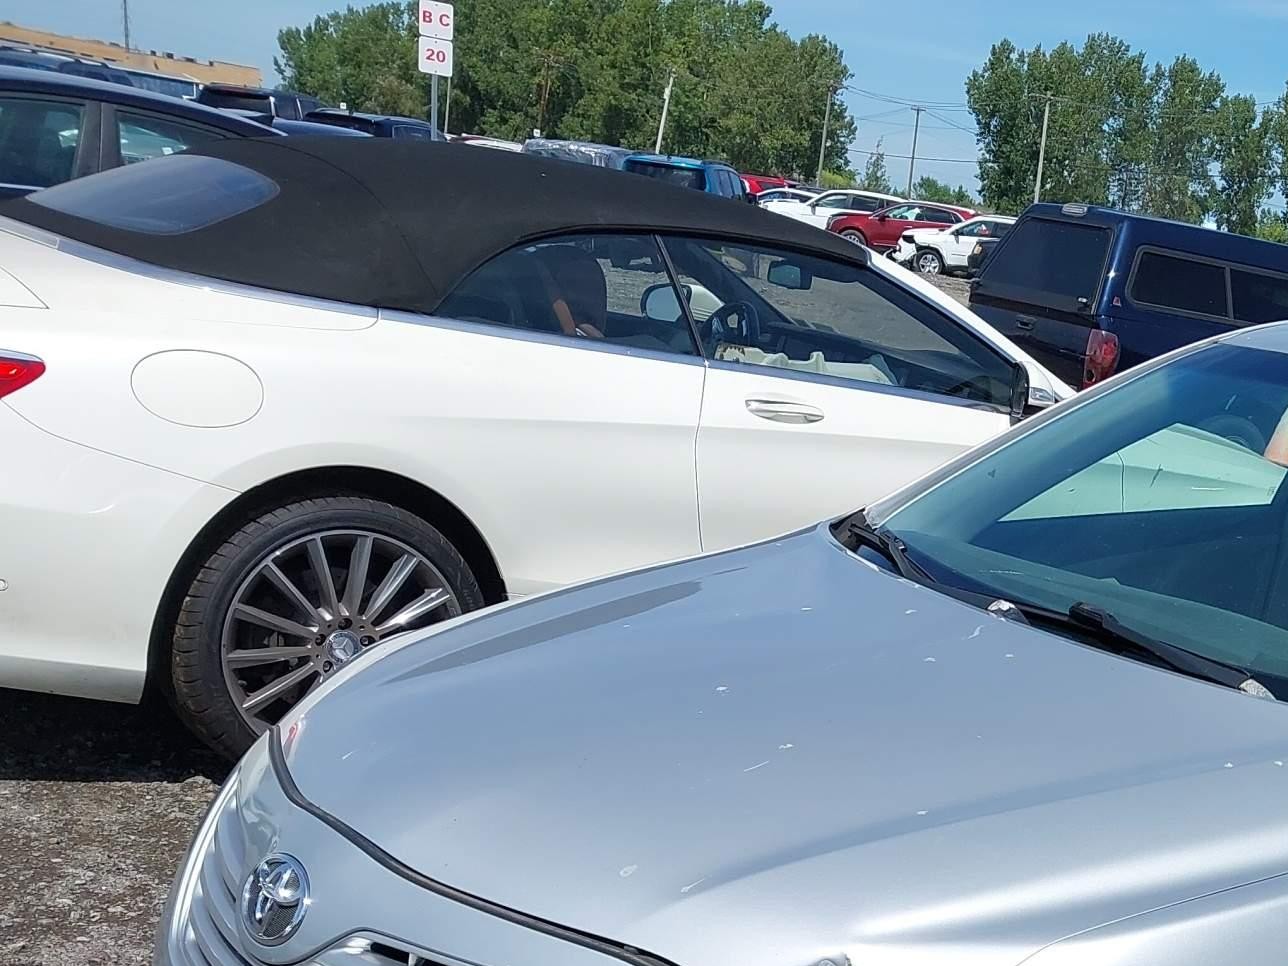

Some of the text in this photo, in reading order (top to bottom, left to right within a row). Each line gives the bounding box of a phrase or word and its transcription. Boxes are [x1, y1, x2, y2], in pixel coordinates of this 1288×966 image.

[422, 10, 450, 27] B C
[425, 48, 446, 63] 20
